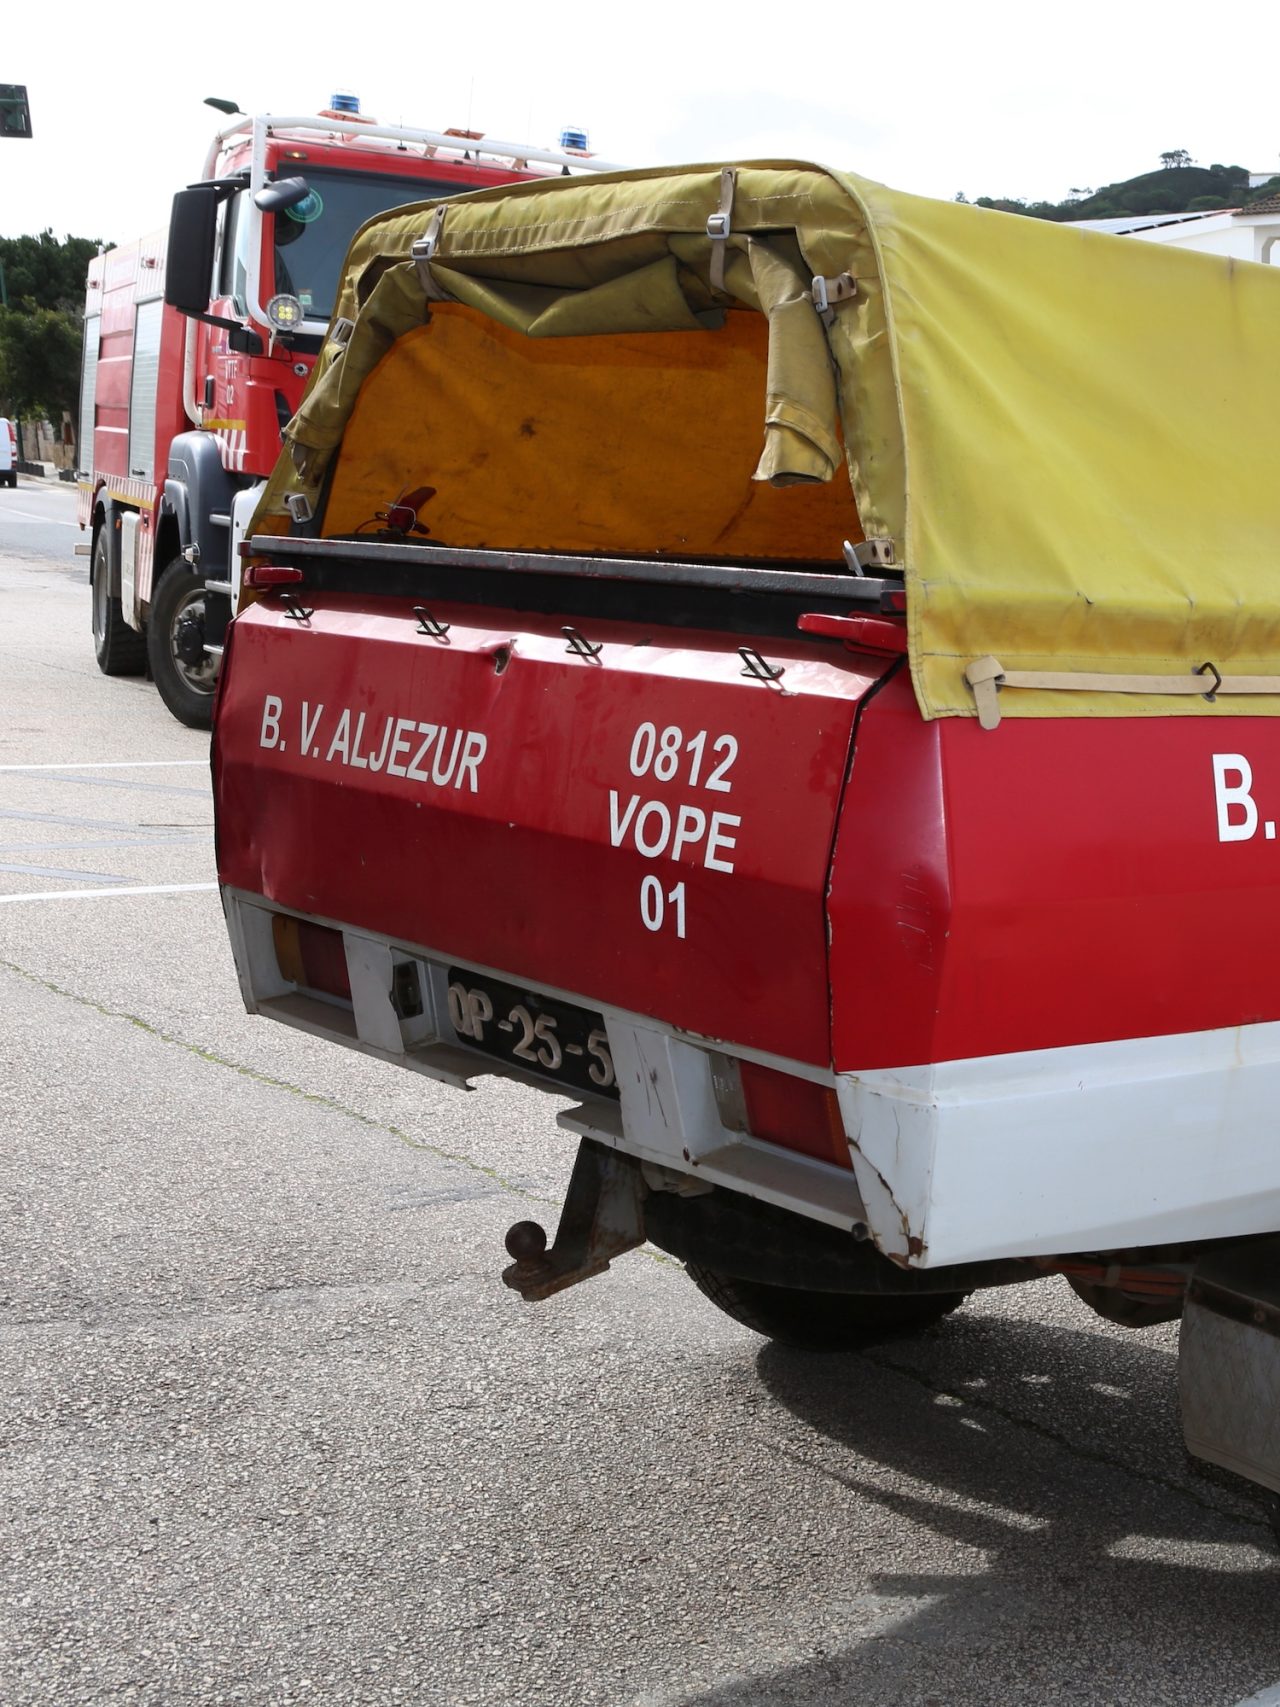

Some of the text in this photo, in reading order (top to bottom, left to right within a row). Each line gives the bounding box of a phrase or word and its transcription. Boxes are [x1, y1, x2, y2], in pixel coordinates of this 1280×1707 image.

[260, 694, 488, 793] B. V. ALJEZUR
[629, 721, 740, 793] 0812
[609, 789, 742, 874] VOPE
[1212, 753, 1276, 843] B.
[640, 874, 687, 939] 01
[449, 981, 619, 1088] QP-25-5
